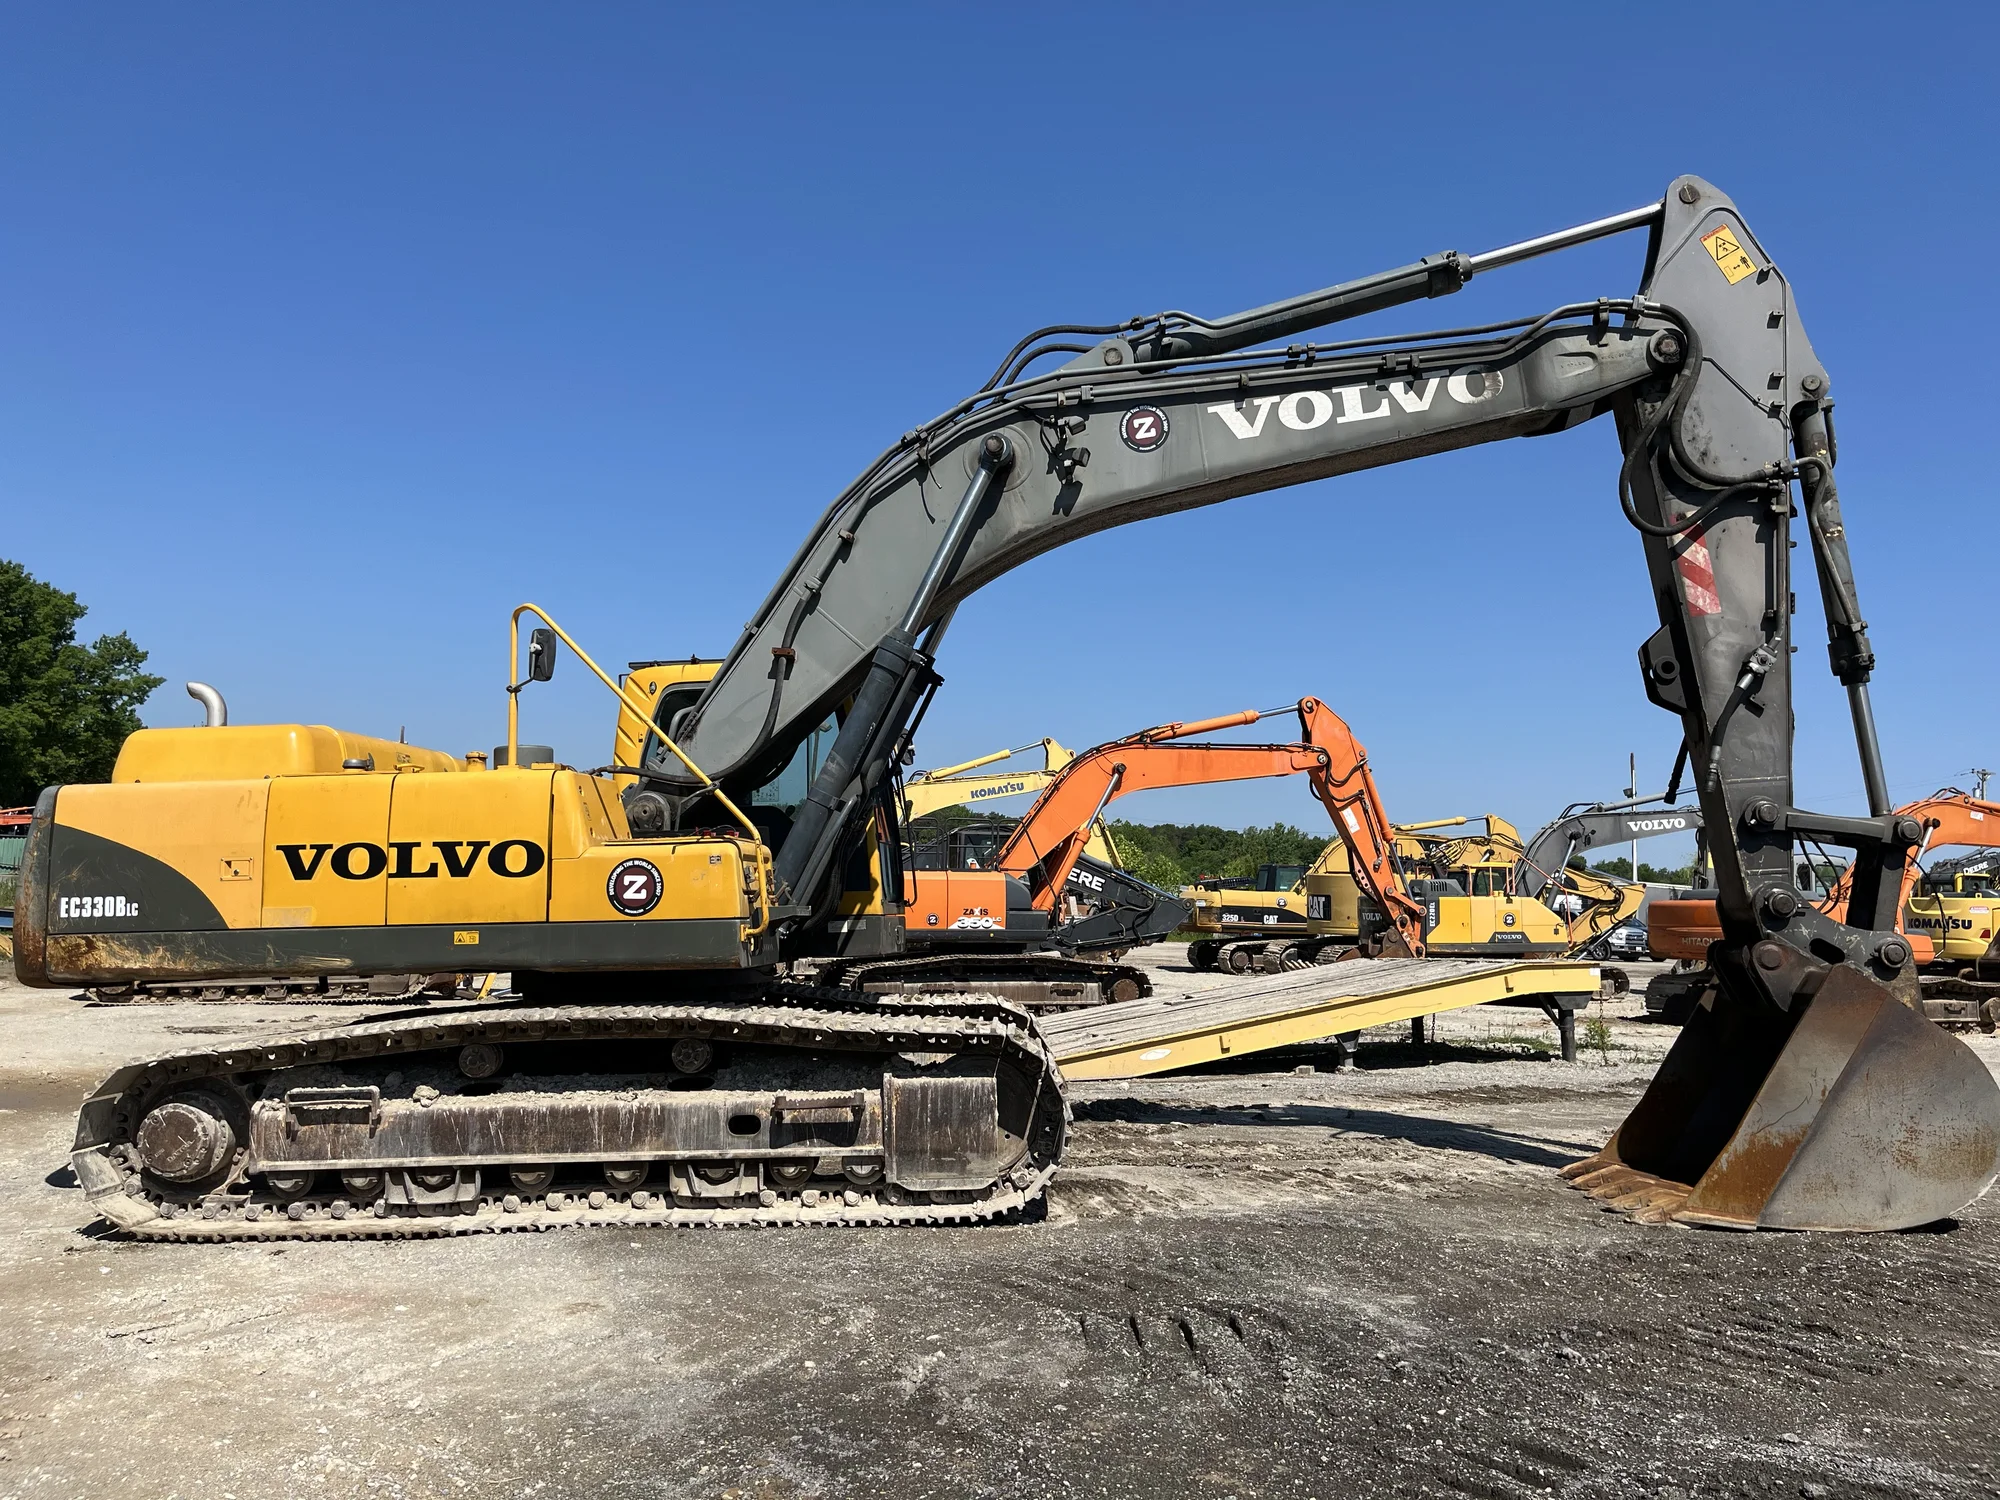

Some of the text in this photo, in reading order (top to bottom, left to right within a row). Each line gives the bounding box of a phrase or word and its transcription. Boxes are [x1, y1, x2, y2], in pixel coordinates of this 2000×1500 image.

[1207, 364, 1504, 440] VOLVO
[1133, 416, 1157, 439] Z
[970, 782, 1025, 799] KOMATSU
[1627, 817, 1686, 832] VOLVO
[275, 840, 545, 880] VOLVO
[1963, 861, 1989, 875] DEERE
[609, 865, 624, 895] DEVELOPING
[622, 860, 634, 868] THE
[633, 860, 653, 870] WORLD
[650, 867, 662, 882] SINCE
[623, 875, 647, 899] Z
[962, 907, 989, 916] ZAXIS
[1308, 895, 1326, 919] CAT
[1263, 914, 1279, 925] CAT
[1361, 912, 1383, 921] VOLV
[1681, 937, 1720, 947] HITAC
